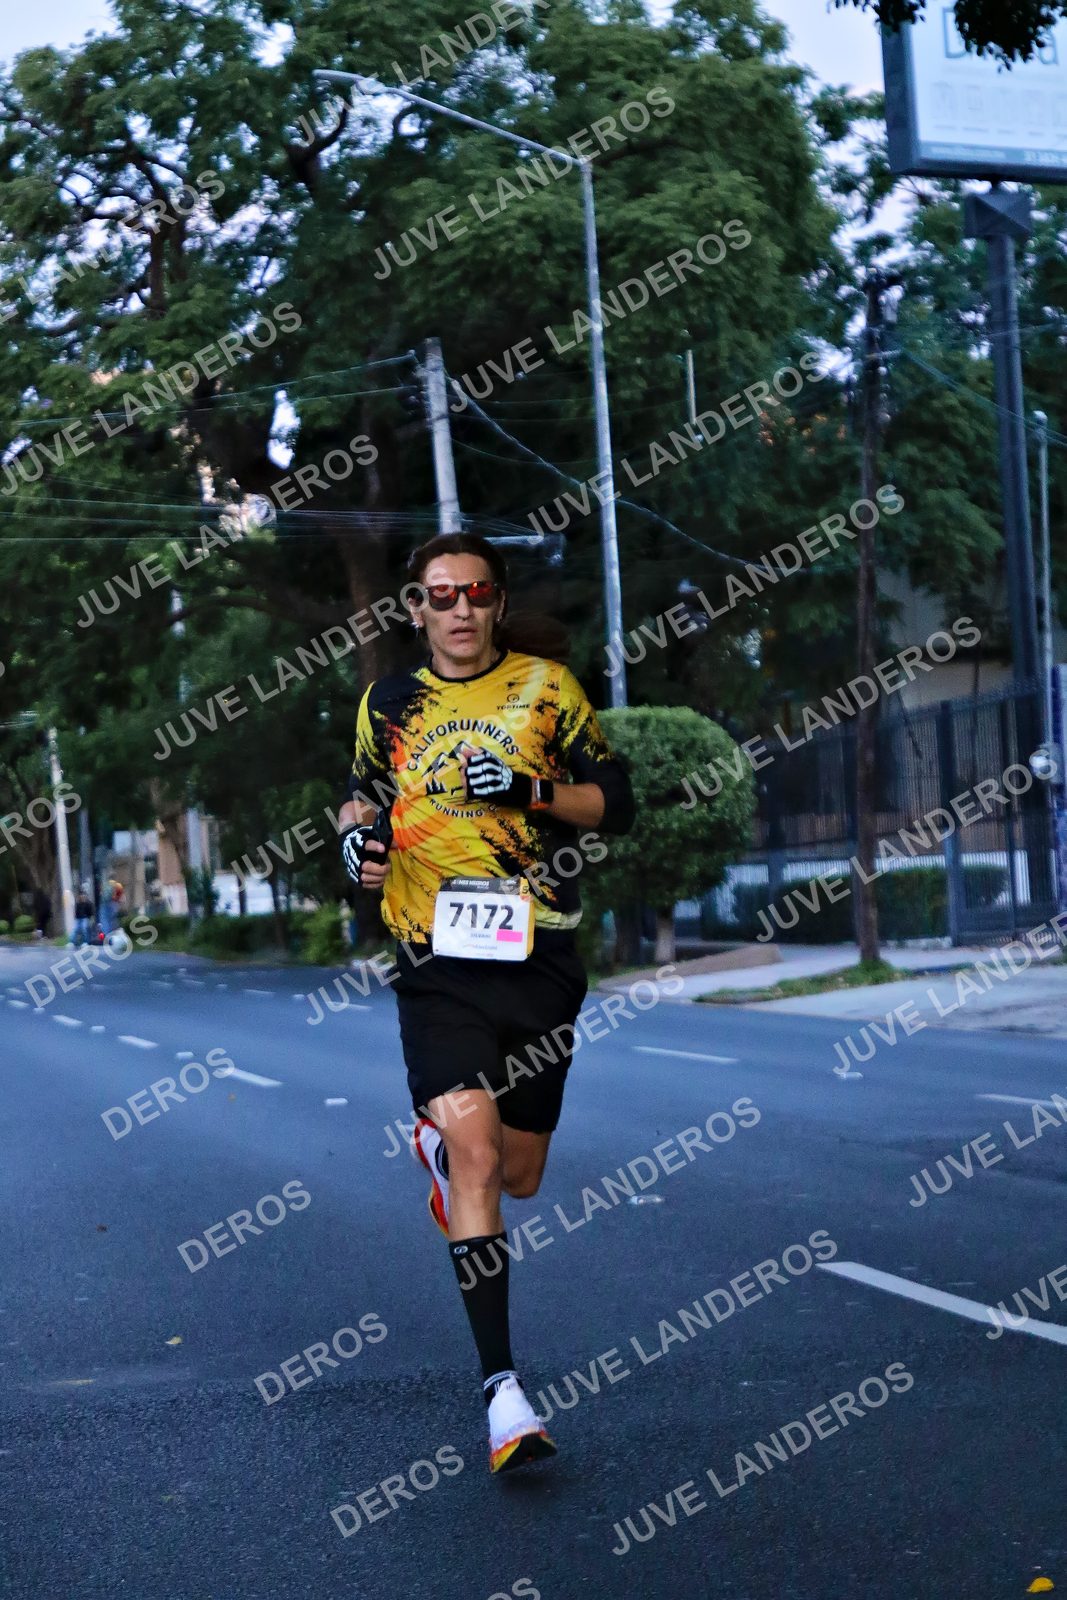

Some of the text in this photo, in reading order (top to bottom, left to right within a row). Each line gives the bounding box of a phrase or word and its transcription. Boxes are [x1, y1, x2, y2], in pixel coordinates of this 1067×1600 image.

[407, 719, 520, 772] CALIFORUNNERS
[429, 798, 485, 818] RUNNING
[449, 902, 514, 930] 7172
